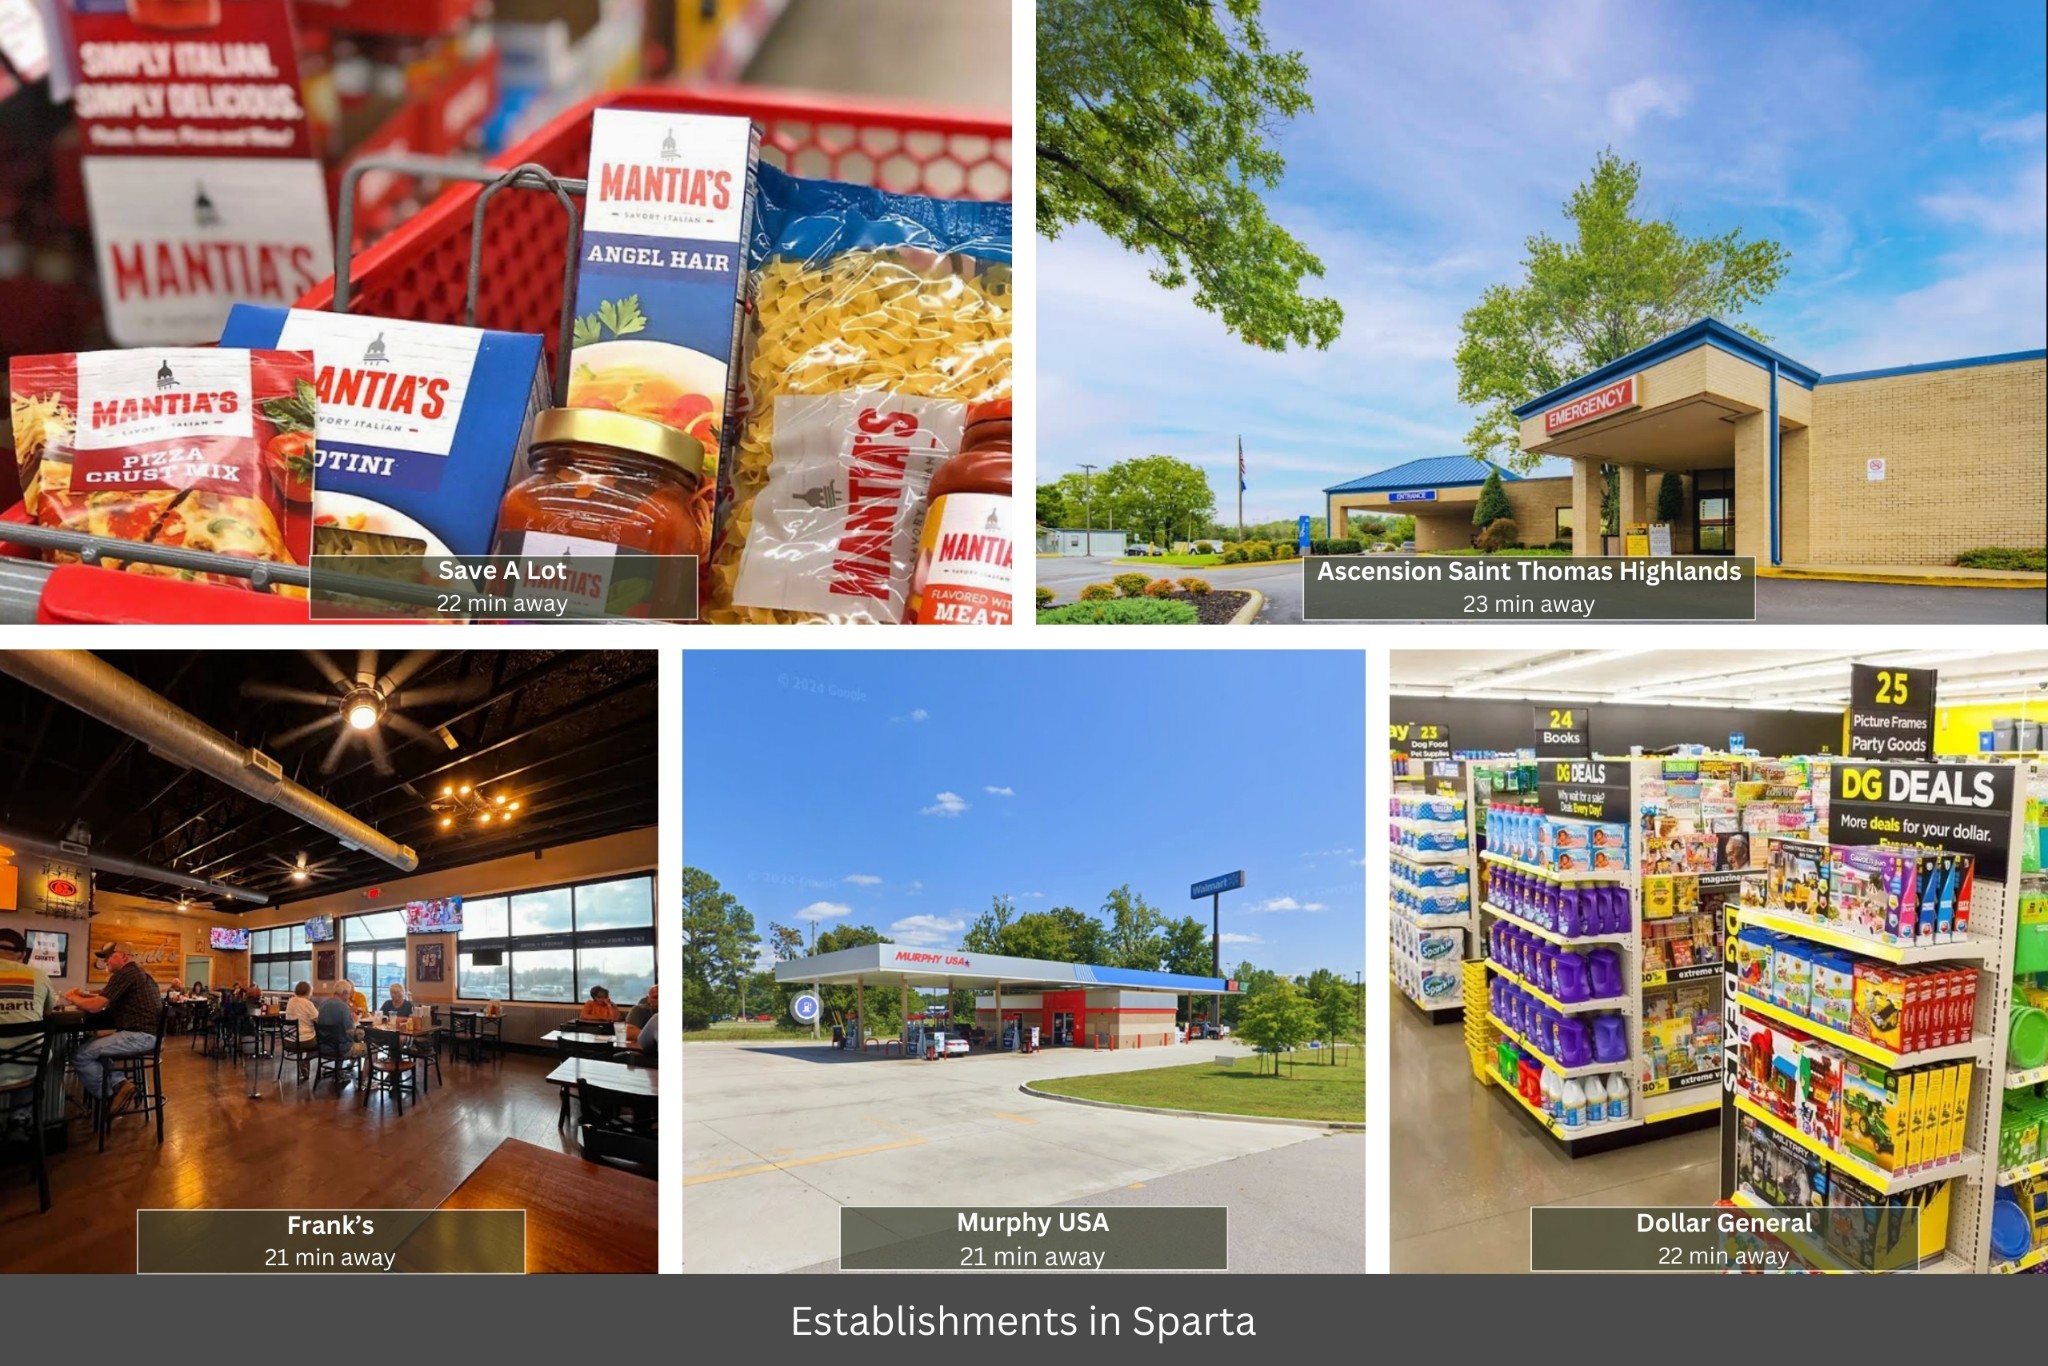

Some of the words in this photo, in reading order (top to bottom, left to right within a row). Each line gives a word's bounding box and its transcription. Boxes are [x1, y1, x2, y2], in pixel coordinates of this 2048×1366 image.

[600, 163, 732, 210] MANTIA'S
[587, 245, 664, 267] ANGEL
[670, 250, 729, 272] HAIR
[111, 240, 317, 302] MANTIA'S
[92, 391, 239, 430] MANTIA'S
[1549, 385, 1625, 428] EMERGENCY
[354, 420, 402, 432] ITALIAN
[122, 447, 204, 469] PIZZA
[86, 465, 177, 483] CRUST
[186, 463, 241, 483] MIX
[829, 408, 919, 601] MANTIA'S
[931, 589, 988, 606] FLAVORED
[934, 603, 1009, 625] MEAT
[1875, 670, 1908, 705] 25
[1550, 709, 1573, 729] 24
[1853, 714, 1890, 728] Picture
[1891, 716, 1928, 729] Frames
[1420, 725, 1438, 739] 23
[1543, 731, 1580, 744] Books
[1411, 741, 1427, 749] Dog
[1428, 740, 1448, 749] Food
[1411, 750, 1422, 758] Pet
[1423, 750, 1450, 759] Supplies
[1852, 736, 1885, 754] Party
[1887, 736, 1927, 752] Goods
[1556, 763, 1570, 783] DG
[1571, 763, 1606, 784] DEALS
[1557, 790, 1569, 801] Why
[1842, 767, 1883, 801] DG
[1888, 769, 1995, 808] DEALS
[1573, 803, 1588, 816] Every
[1589, 804, 1603, 818] Day!
[1841, 813, 1868, 829] More
[1869, 816, 1900, 832] deals
[1903, 818, 1920, 834] for
[1922, 824, 1950, 840] your
[1952, 824, 1992, 842] dollar.
[1192, 877, 1228, 895] Walmart
[1725, 907, 1740, 964] DG
[1421, 938, 1453, 958] Sparkle
[422, 953, 437, 967] 43
[896, 951, 942, 964] MURPHY
[945, 956, 965, 966] USA
[1679, 967, 1713, 979] extreme
[1424, 975, 1456, 995] Sparkle
[1723, 975, 1739, 1094] DEALS
[1680, 1073, 1714, 1086] extreme
